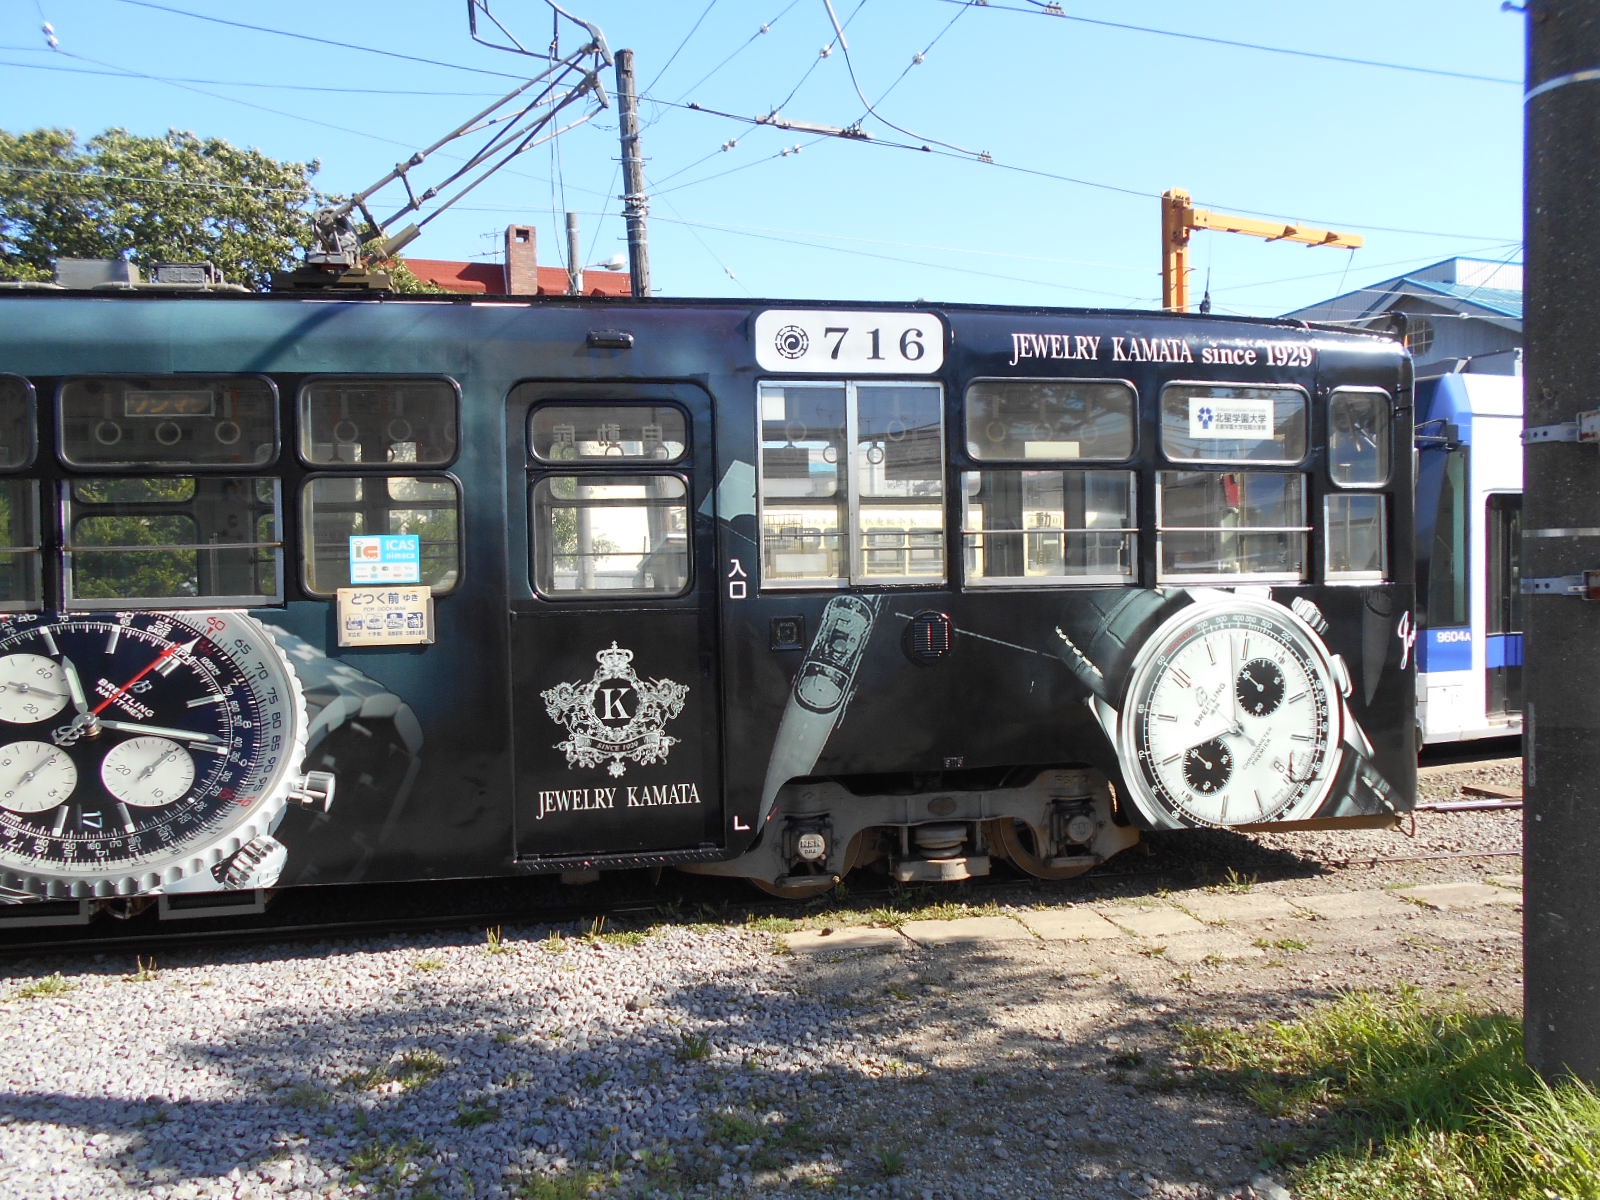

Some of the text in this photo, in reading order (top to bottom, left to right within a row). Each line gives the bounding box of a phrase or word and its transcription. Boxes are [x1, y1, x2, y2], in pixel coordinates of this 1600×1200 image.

[824, 327, 925, 361] 716
[1009, 333, 1313, 368] JEWELRY KAMATA since 1929
[1215, 412, 1267, 424] 北星学園大学
[728, 559, 747, 599] 入口
[146, 624, 170, 638] BASE
[206, 617, 226, 631] 60
[234, 639, 252, 655] 65
[36, 667, 53, 679] 60
[255, 661, 269, 680] 70
[97, 677, 155, 717] BREITLING
[267, 687, 279, 705] 75
[600, 687, 632, 720] K
[23, 703, 39, 715] 20
[242, 720, 252, 729] 8
[272, 711, 282, 729] 80
[271, 735, 281, 752] 85
[115, 764, 131, 776] 20
[263, 756, 276, 774] 90
[151, 787, 164, 798] 10
[253, 776, 267, 792] 95
[536, 783, 701, 820] JEWELRY KAMATA
